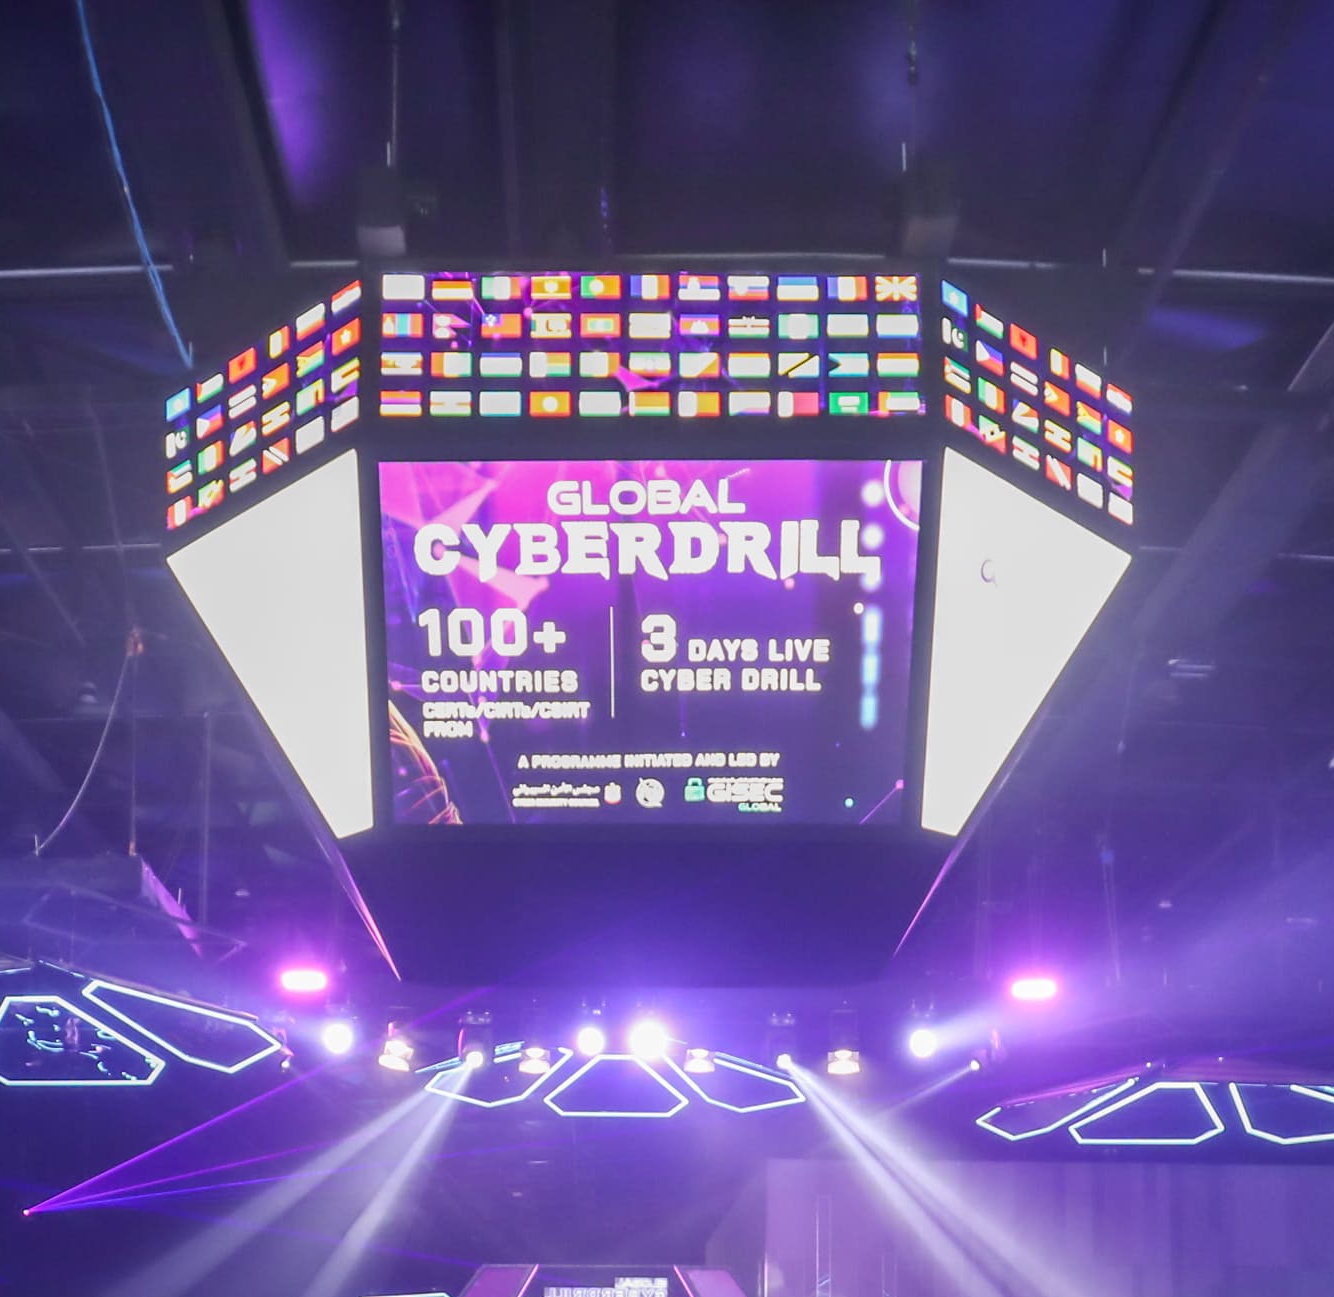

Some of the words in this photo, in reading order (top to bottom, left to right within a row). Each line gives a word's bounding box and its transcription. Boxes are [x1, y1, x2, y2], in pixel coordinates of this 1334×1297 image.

[547, 478, 746, 515] GLOBAL
[413, 519, 881, 582] CYBERDRILL
[418, 607, 566, 657] 100+
[641, 613, 678, 664] 3
[688, 639, 760, 662] DAYS
[768, 638, 830, 662] LIVE
[421, 670, 579, 693] COUNTRIES
[641, 669, 732, 692] CYBER
[741, 668, 822, 691] DRILL
[423, 720, 473, 738] FROM
[517, 754, 530, 769] A
[531, 754, 621, 769] PROGRAMME
[624, 753, 693, 768] INITIATED
[694, 752, 727, 767] AND
[728, 752, 758, 767] LED
[759, 752, 781, 767] BY
[707, 782, 784, 803] GISEC
[737, 802, 782, 813] GLOBAL
